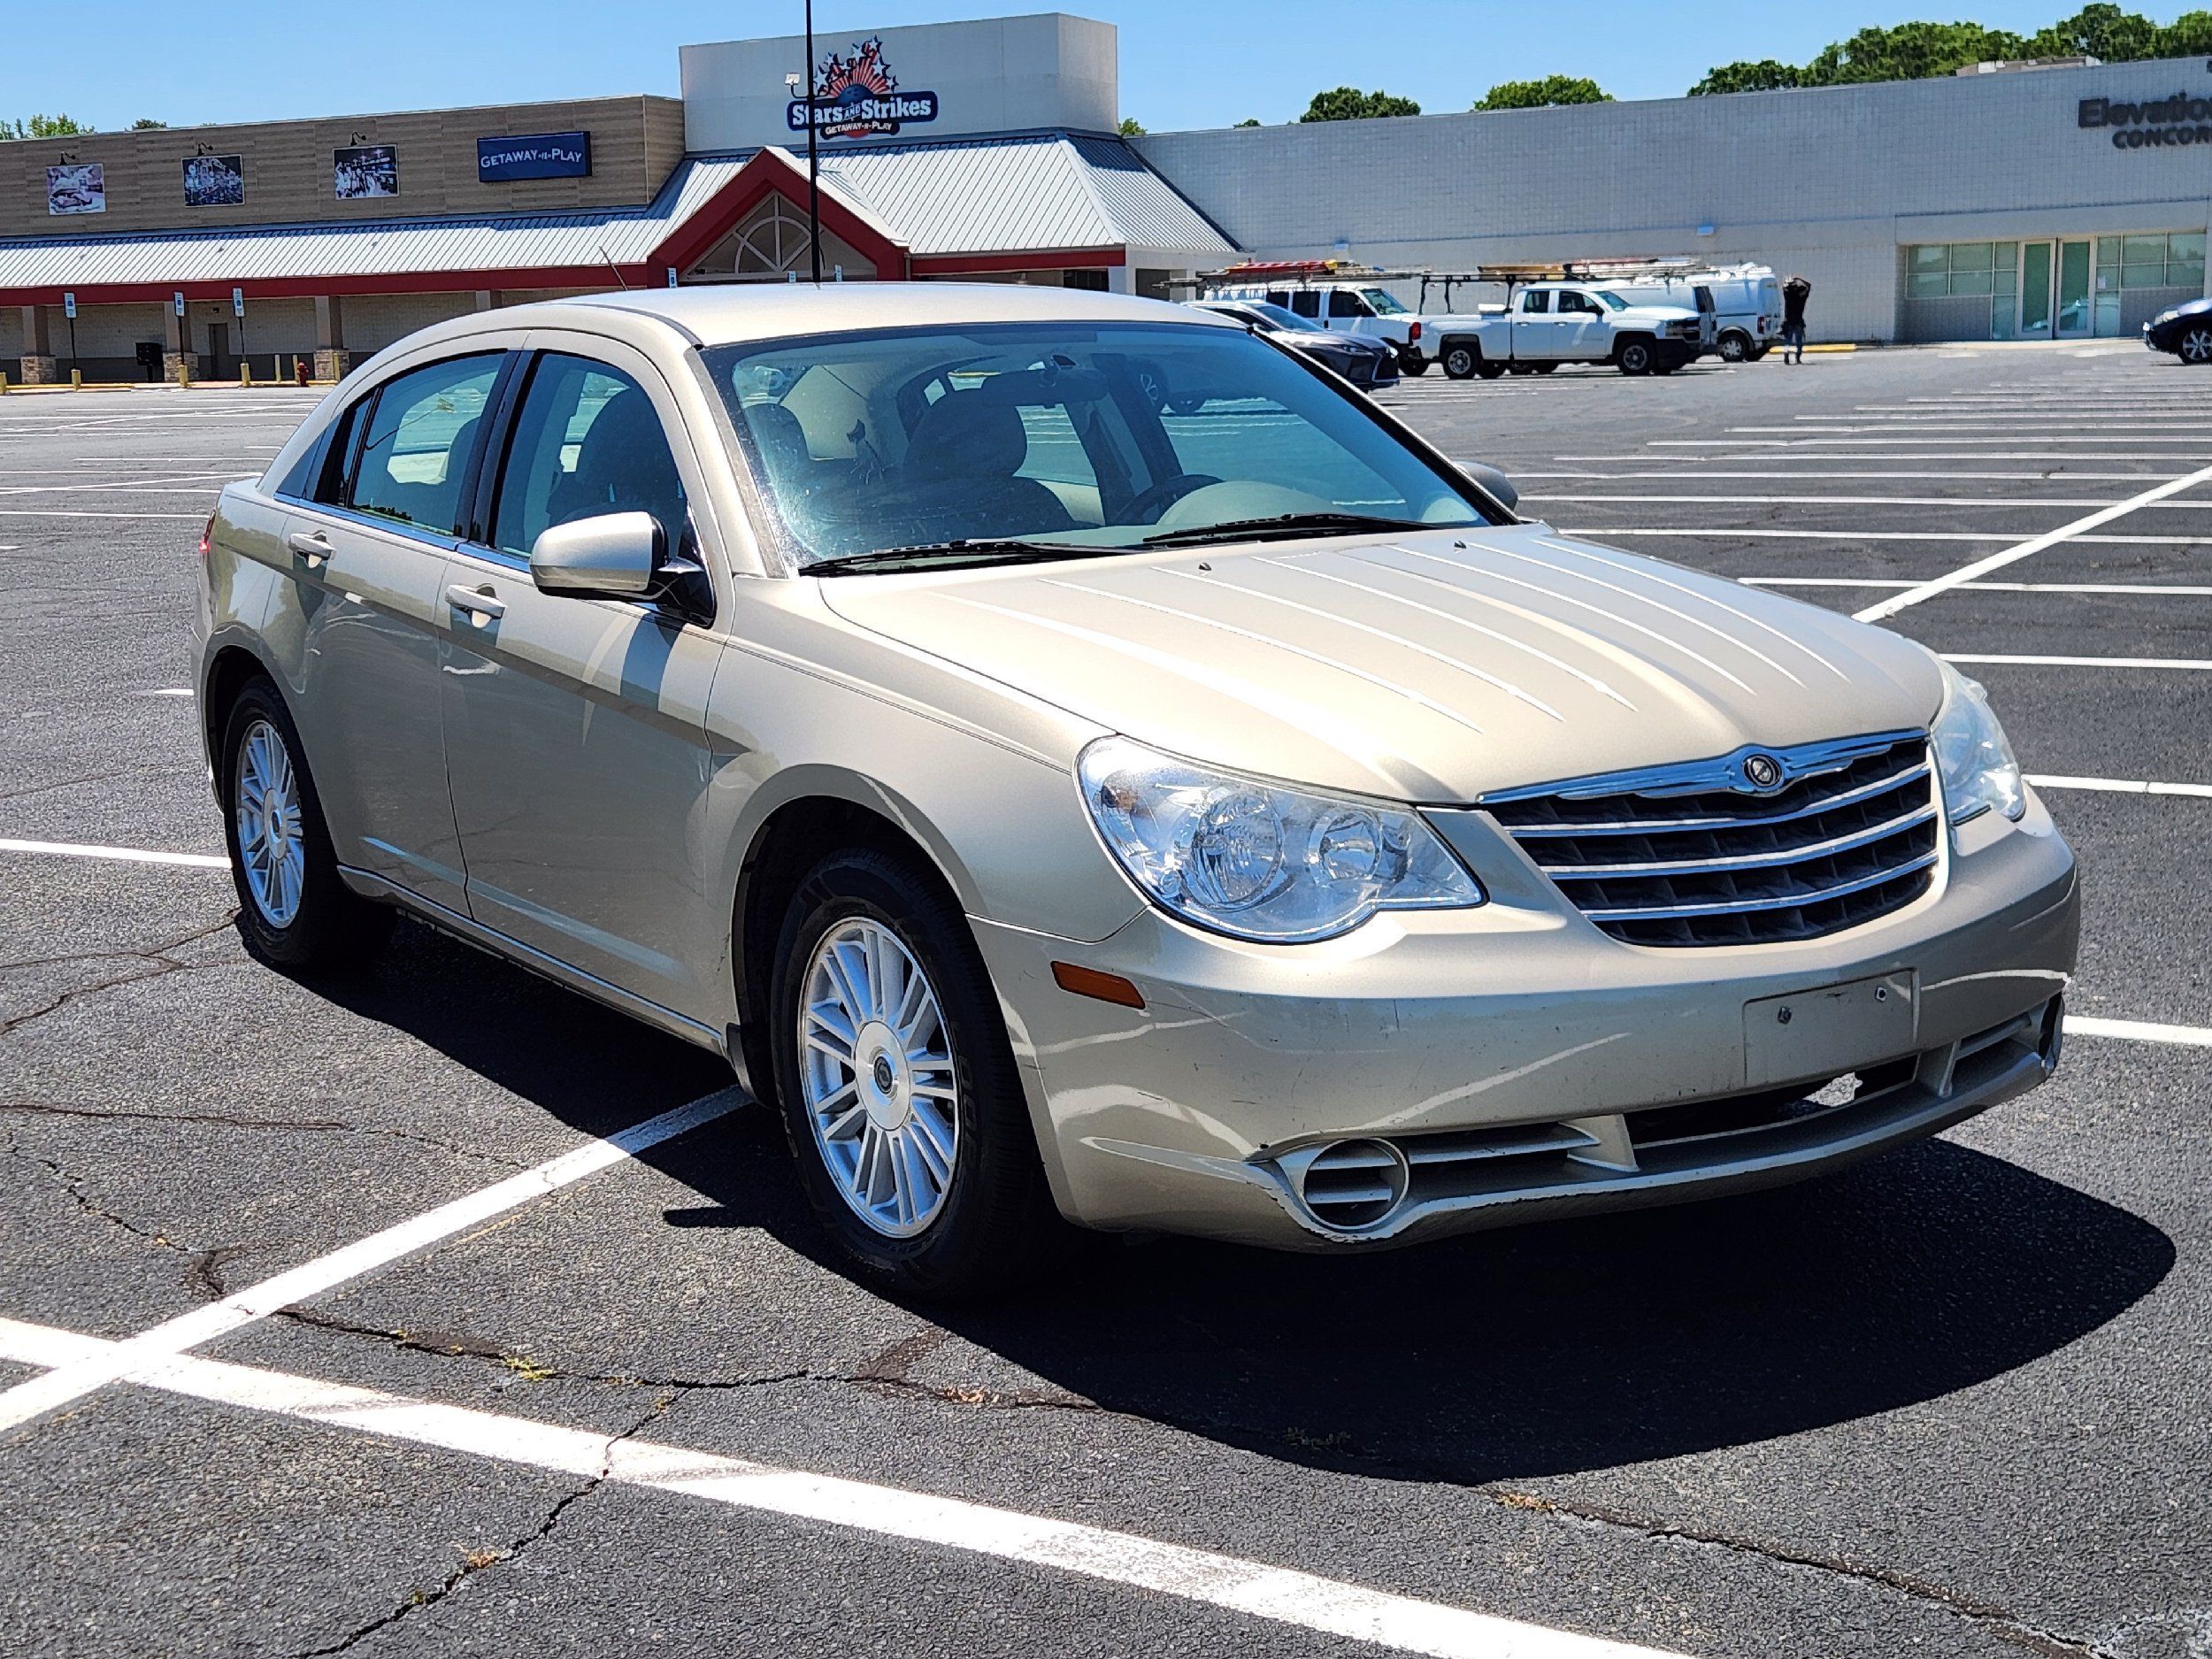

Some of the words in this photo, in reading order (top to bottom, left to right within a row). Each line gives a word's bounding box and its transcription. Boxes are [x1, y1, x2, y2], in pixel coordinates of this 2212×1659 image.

[844, 105, 861, 119] AND
[861, 96, 932, 119] Strikes
[2078, 91, 2212, 127] Elevatio
[2112, 127, 2212, 149] CONCOR
